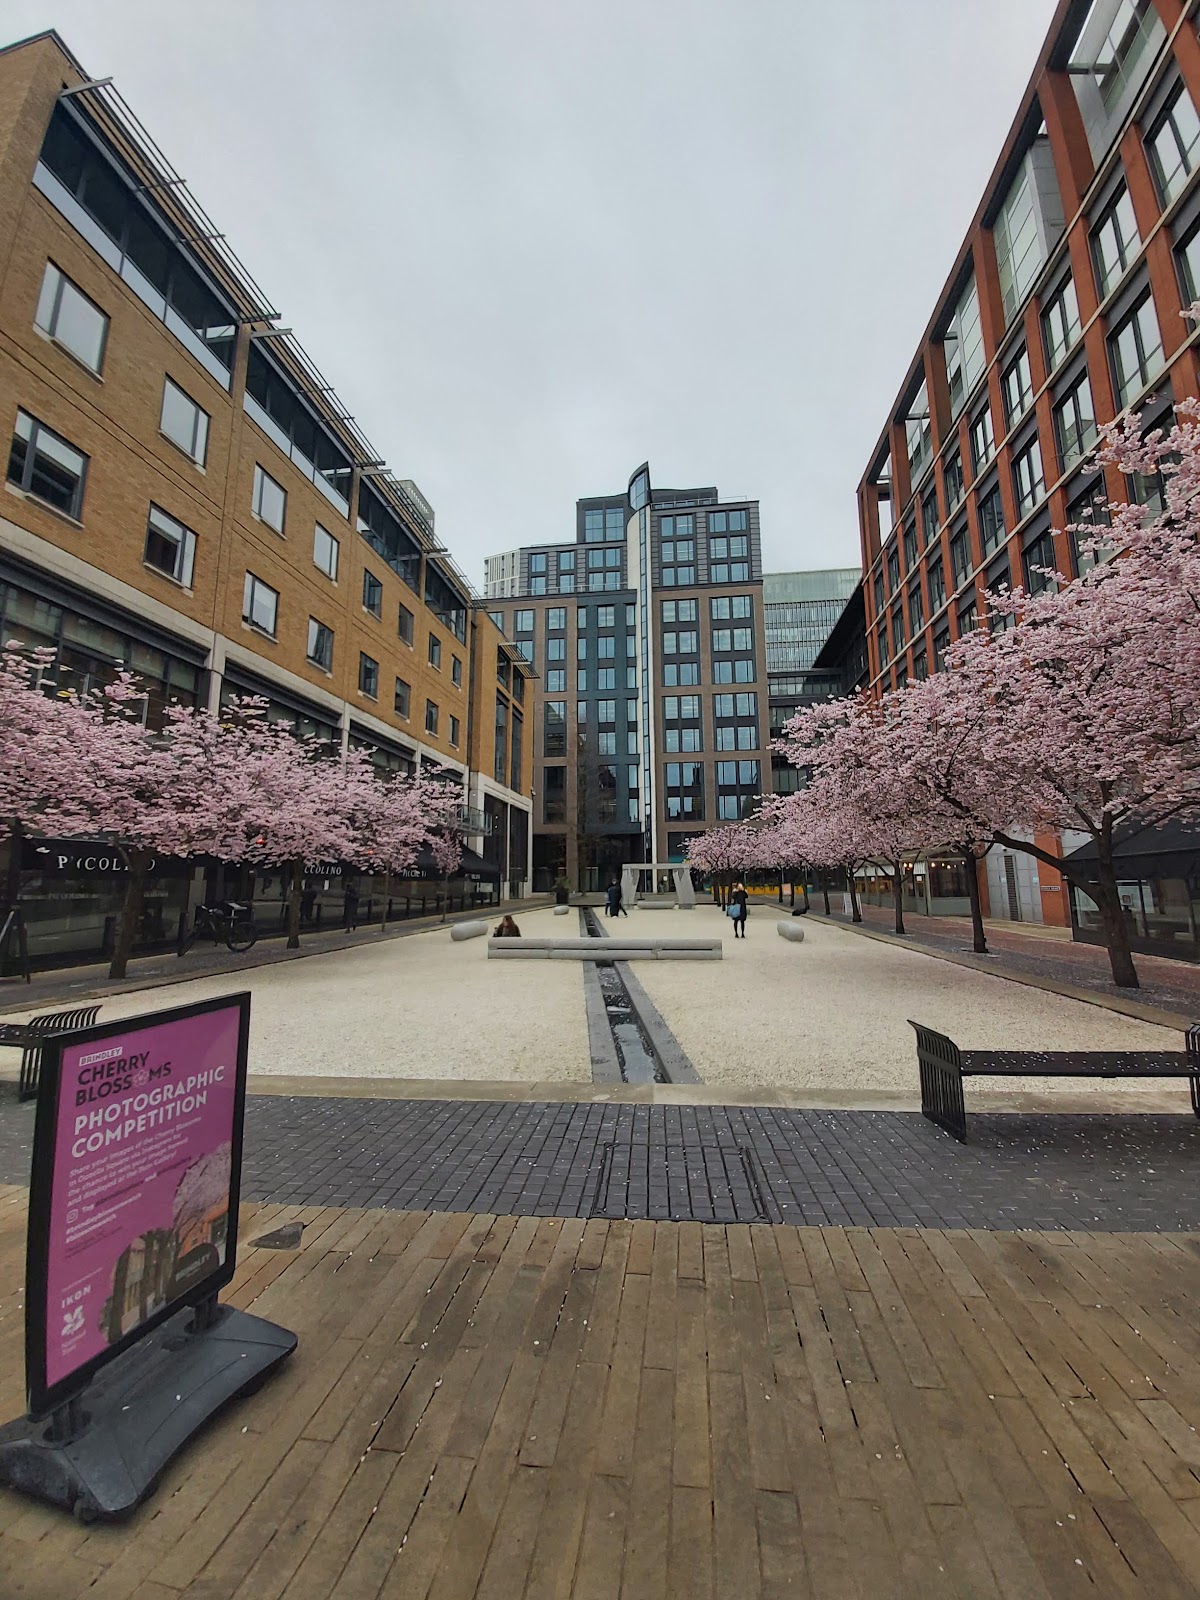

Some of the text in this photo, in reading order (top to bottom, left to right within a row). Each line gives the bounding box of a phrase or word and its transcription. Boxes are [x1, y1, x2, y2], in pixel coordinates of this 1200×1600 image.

[77, 1051, 150, 1086] CHERRY
[80, 1048, 122, 1065] BRINDLEY
[74, 1065, 225, 1136] PHOTOGRAPHIC
[71, 1090, 208, 1158] COMPETITION
[91, 1157, 108, 1168] your
[61, 1284, 91, 1310] IKON
